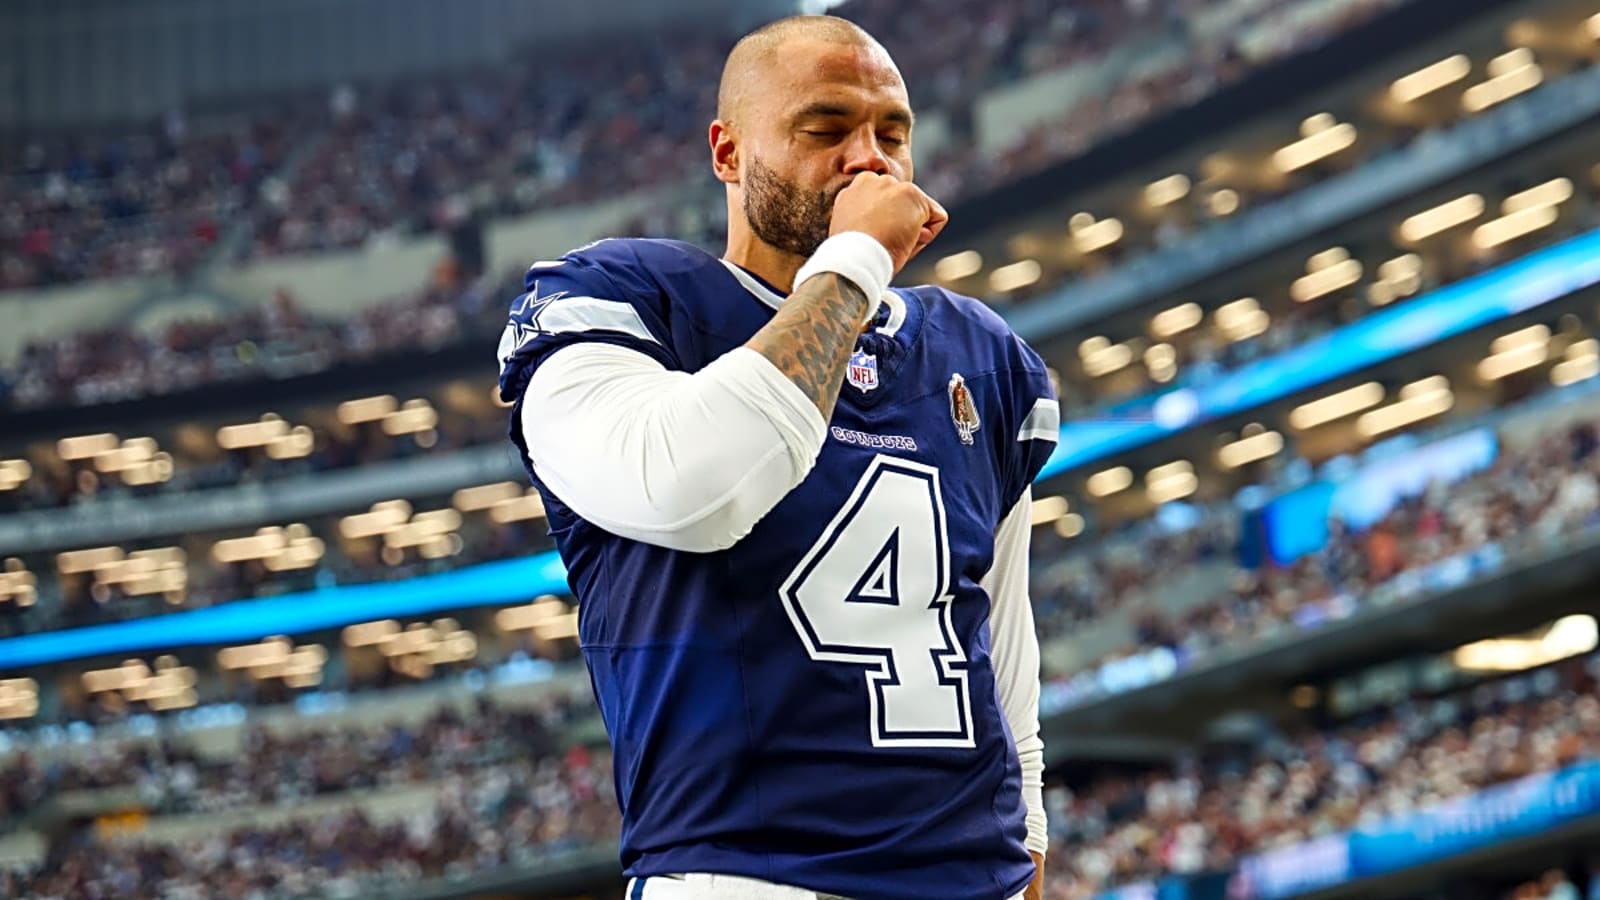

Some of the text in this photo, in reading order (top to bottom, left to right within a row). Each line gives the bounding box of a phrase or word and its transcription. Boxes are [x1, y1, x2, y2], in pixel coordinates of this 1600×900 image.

[852, 366, 874, 384] NFL
[831, 426, 917, 451] COWBOYS
[778, 453, 976, 747] 4
